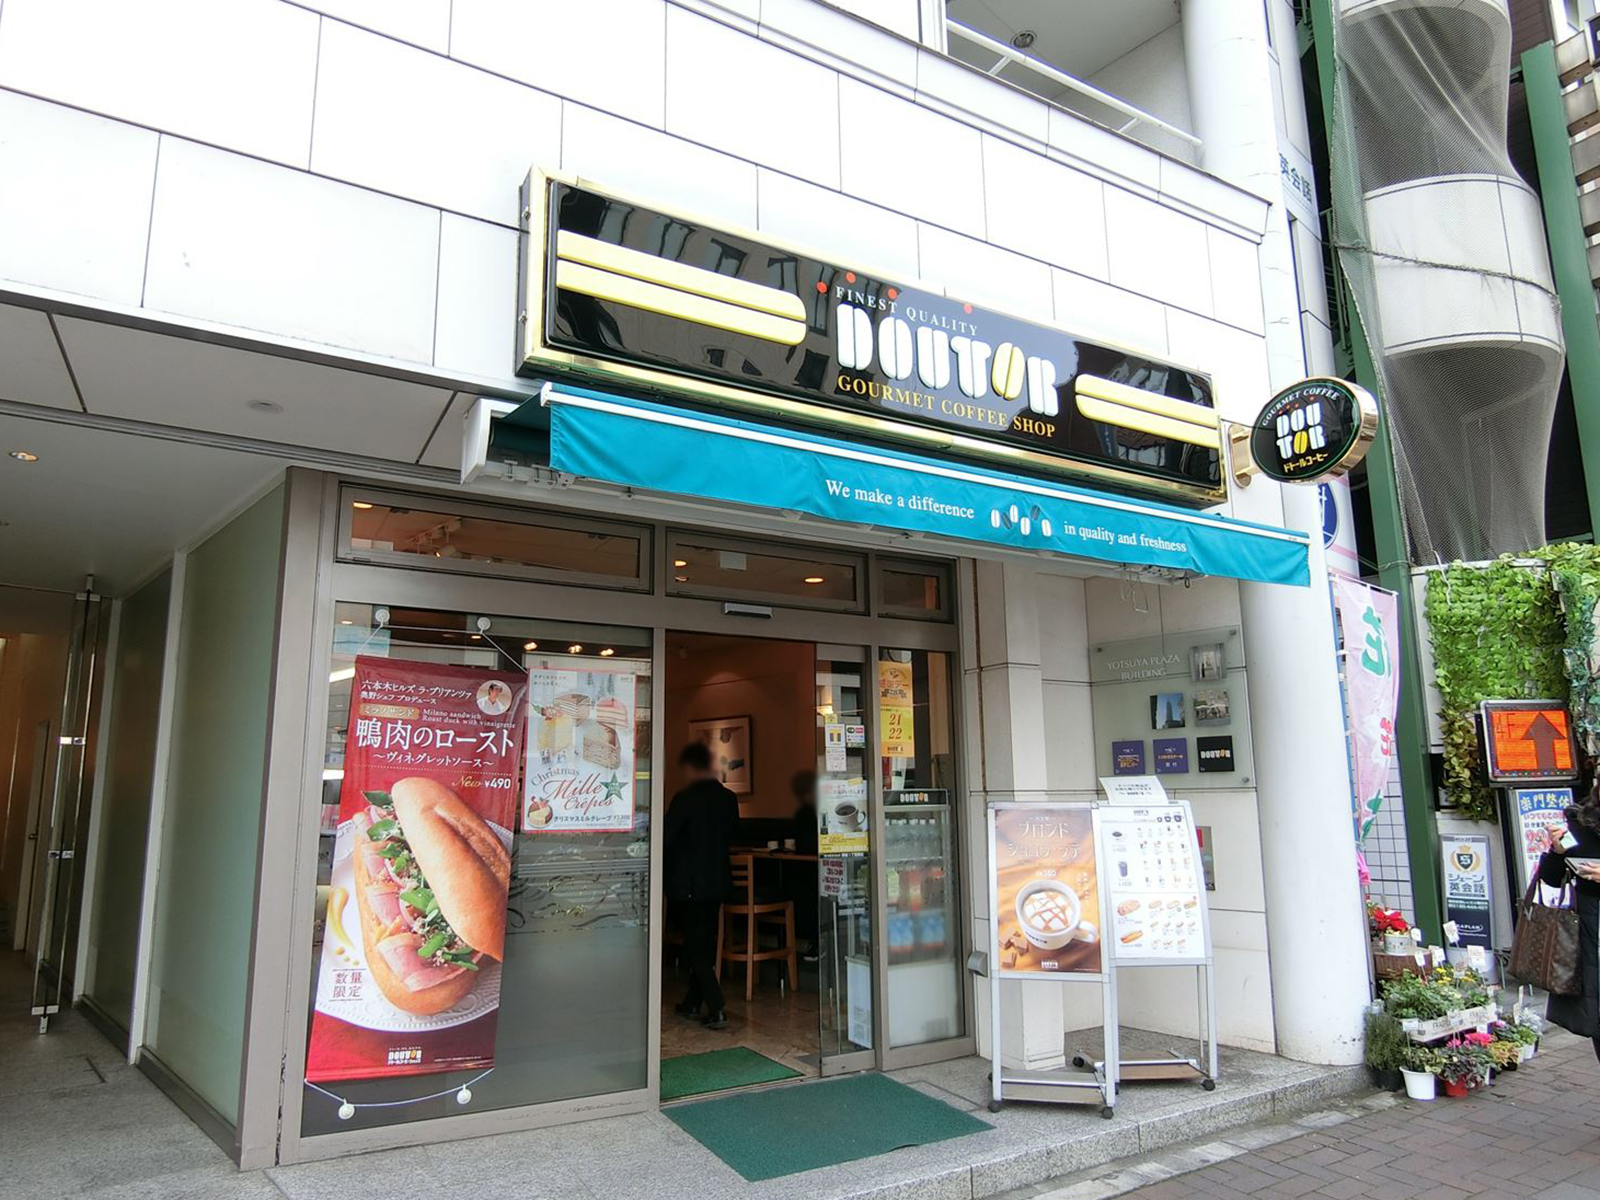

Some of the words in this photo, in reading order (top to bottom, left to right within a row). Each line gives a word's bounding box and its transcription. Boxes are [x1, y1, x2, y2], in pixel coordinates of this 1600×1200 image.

[836, 286, 898, 313] FINEST
[906, 307, 977, 336] QUALITY
[837, 303, 1059, 417] DOUTOR
[837, 375, 936, 410] GOURMET
[941, 400, 1008, 427] COFFEE
[1012, 415, 1056, 438] SHOP
[1262, 391, 1300, 426] GOURMET
[1303, 387, 1340, 401] COFFEE
[1283, 452, 1328, 473] ドトールコーヒー
[825, 479, 850, 498] We
[854, 488, 893, 505] make
[897, 495, 905, 508] a
[908, 495, 975, 519] difference
[1064, 521, 1076, 535] in
[1079, 526, 1115, 545] quality
[1117, 533, 1137, 546] and
[1139, 534, 1187, 552] freshness
[1107, 657, 1148, 670] YOTSUYA
[1150, 654, 1180, 665] PLAZA
[1121, 668, 1166, 680] BUILDING
[361, 680, 416, 693] 六本木ヒルズ
[363, 705, 415, 717] ミラノサンド
[423, 708, 448, 717] Milano
[450, 710, 481, 720] sandwich
[422, 715, 442, 723] Roast
[444, 716, 460, 724] duck
[462, 718, 477, 726] with
[889, 713, 902, 726] 21
[355, 717, 515, 758] 鴨肉のロースト
[888, 727, 903, 740] 22
[452, 775, 482, 788] New
[484, 778, 511, 789] ¥490
[531, 767, 580, 787] Christmas
[543, 773, 603, 800] Mille
[553, 814, 612, 823] クリスマスミルクレープ
[1448, 873, 1484, 883] シェーン
[1449, 882, 1485, 893] 英会話
[335, 971, 362, 984] 数量
[333, 985, 361, 998] 限定
